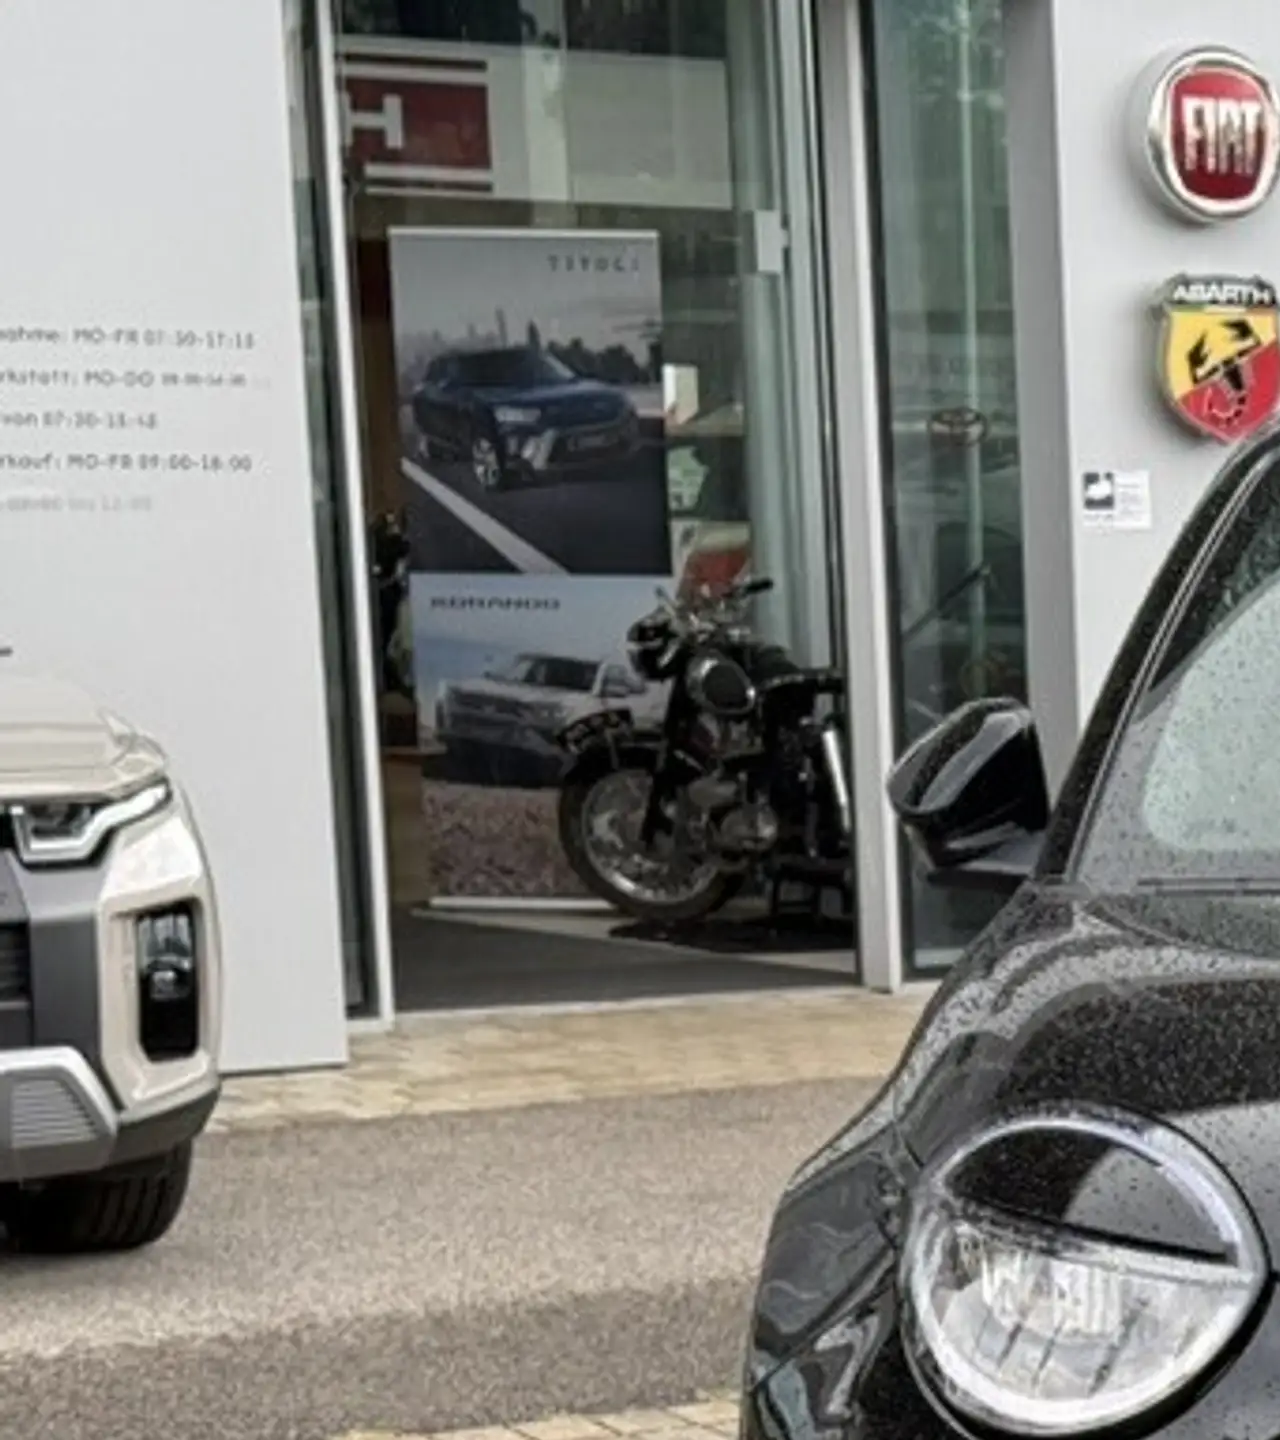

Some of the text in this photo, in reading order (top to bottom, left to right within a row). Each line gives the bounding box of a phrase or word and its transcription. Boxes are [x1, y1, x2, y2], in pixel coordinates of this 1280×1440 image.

[1181, 95, 1261, 175] FIAT
[1172, 281, 1275, 305] ABARTH
[73, 327, 139, 346] MO-FR
[84, 369, 155, 389] MO-DO
[67, 452, 133, 471] MO-FR
[430, 596, 562, 611] KORANDO
